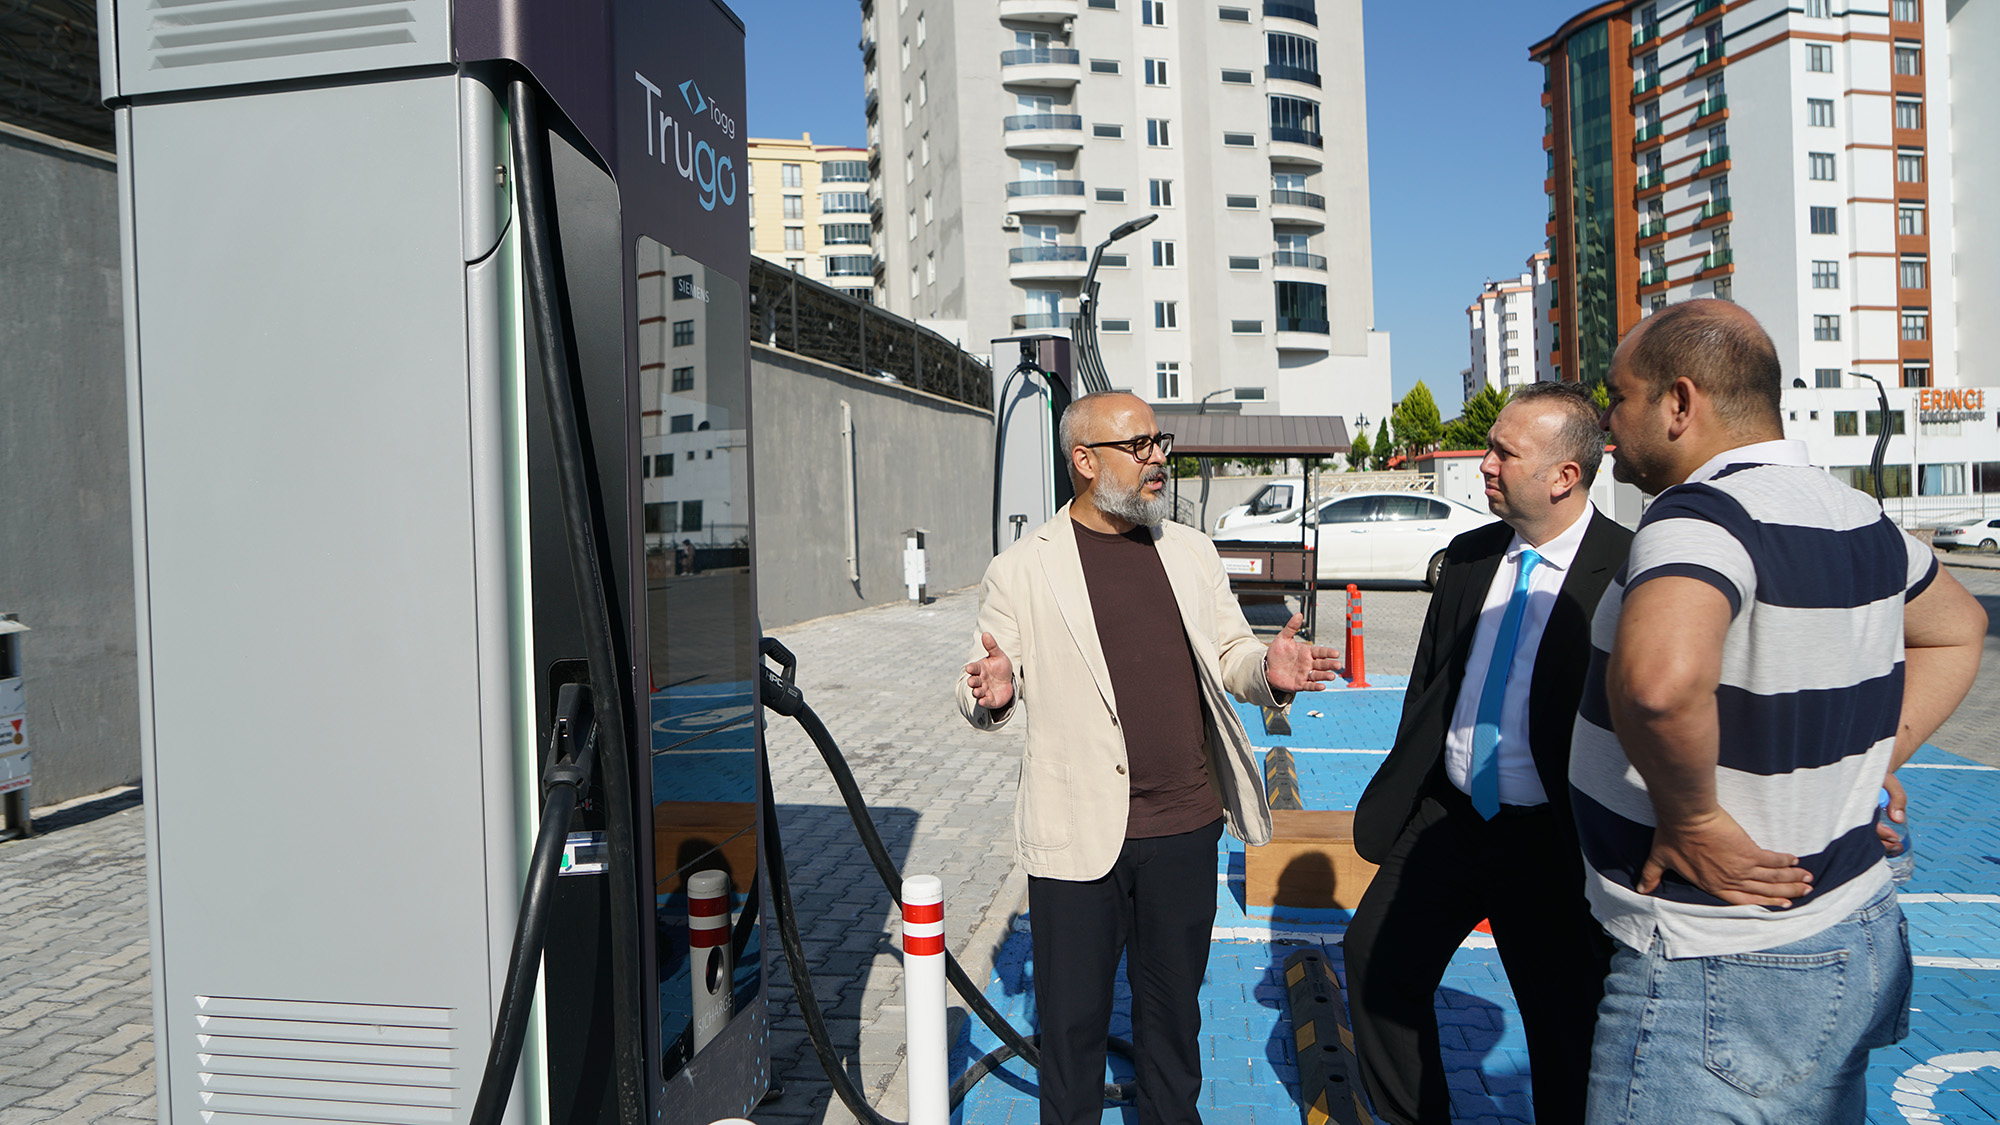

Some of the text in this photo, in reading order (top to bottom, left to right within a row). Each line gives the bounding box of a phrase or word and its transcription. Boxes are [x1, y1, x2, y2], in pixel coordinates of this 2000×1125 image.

[708, 97, 735, 139] Togg
[635, 71, 736, 211] Trugo
[678, 278, 710, 304] SIEMENS
[765, 669, 784, 688] HPC
[697, 991, 733, 1037] SICHARGE
